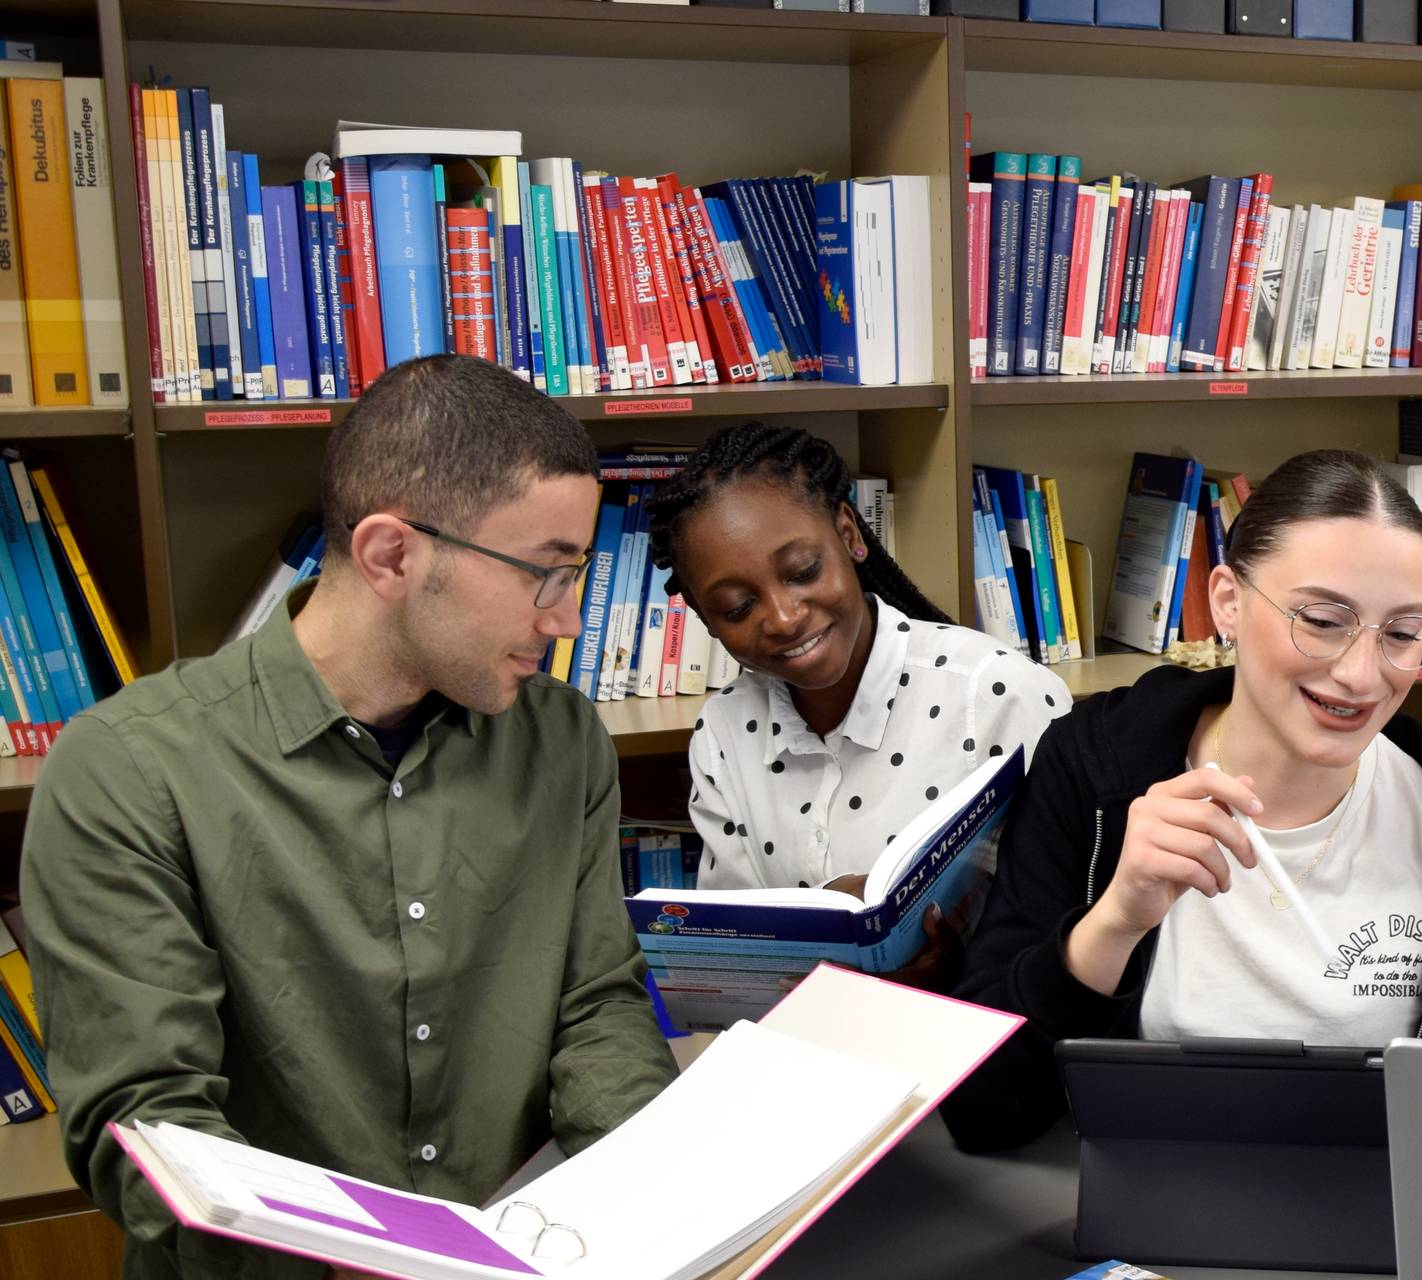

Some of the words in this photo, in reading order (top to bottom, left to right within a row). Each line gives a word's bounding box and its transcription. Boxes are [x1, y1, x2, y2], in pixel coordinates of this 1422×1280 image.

[29, 98, 50, 184] Dekubitus
[72, 130, 83, 149] zur
[80, 97, 98, 187] Krankenpflege
[75, 152, 87, 187] Folien
[184, 130, 199, 226] Krankenpflegeprozess
[199, 129, 216, 225] Krankenpflegeprozess
[594, 194, 606, 228] Patienten
[641, 196, 653, 225] Pflege
[1135, 190, 1145, 208] Auflage
[1147, 190, 1156, 208] Auflage
[1218, 182, 1228, 209] Geriatrie
[351, 200, 361, 226] Lunney
[359, 200, 372, 256] Pflegediagnostik
[654, 196, 675, 260] Pflegesituationen
[669, 203, 680, 226] Pflege
[674, 192, 702, 261] Pflege-Consulting
[688, 205, 709, 238] pflegen
[999, 200, 1011, 260] GESUNDHEITS-
[1028, 188, 1042, 262] PFLEGETHEORIE
[1408, 201, 1422, 248] campus
[189, 228, 200, 246] Der
[206, 227, 217, 245] Der
[599, 229, 608, 243] der
[622, 196, 657, 304] Pflegeexperten
[647, 225, 657, 242] der
[650, 242, 660, 253] in
[673, 226, 683, 240] der
[1352, 224, 1364, 243] der
[312, 245, 323, 293] Pflegeplanung
[327, 245, 338, 293] Pflegeplanung
[457, 226, 469, 279] Geissler-Murr
[469, 226, 481, 281] Maßnahmen
[601, 243, 615, 291] Privatsphäre
[678, 248, 694, 285] Coaching
[702, 238, 725, 288] Angehörige
[998, 260, 1008, 278] UND
[1036, 247, 1045, 289] KONKRET
[1126, 262, 1135, 276] Band
[1137, 262, 1146, 276] Band
[1224, 267, 1238, 305] Davenport
[1238, 213, 1247, 230] Alte
[1345, 245, 1361, 294] Lehrbuch
[1356, 226, 1379, 297] Geriatrie
[364, 257, 375, 297] Arbeitsbuch
[471, 282, 482, 300] und
[653, 253, 670, 298] Leitbilder
[697, 262, 712, 292] Norwood
[1009, 255, 1018, 294] KONKRET
[1027, 264, 1036, 288] UND
[1122, 278, 1133, 303] Geriatrie
[1133, 278, 1144, 303] Geriatrie
[317, 294, 325, 309] leicht
[332, 294, 340, 309] leicht
[461, 285, 471, 329] Moorhouse
[514, 292, 524, 336] Pflegeforschung
[607, 291, 617, 304] Die
[688, 287, 700, 311] Loffing
[1023, 288, 1034, 326] -PRAXIS
[319, 309, 329, 344] gemacht
[333, 309, 343, 344] gemacht
[1047, 356, 1058, 369] A
[322, 378, 334, 393] A
[590, 551, 615, 606] AUFLAGEN
[587, 605, 605, 629] UND
[580, 629, 602, 671] WICKEL
[642, 674, 652, 689] A
[663, 679, 673, 692] A
[894, 865, 928, 908] Der
[927, 787, 998, 866] Mensch
[896, 868, 937, 919] Anatomie
[935, 856, 954, 875] und
[952, 805, 998, 861] Physiologie
[1323, 920, 1379, 980] WALT
[1359, 953, 1377, 966] It's
[1376, 952, 1400, 965] kind
[1401, 953, 1413, 966] of
[1373, 971, 1386, 981] to
[1386, 970, 1400, 981] do
[1401, 970, 1419, 981] the
[13, 1095, 28, 1113] A
